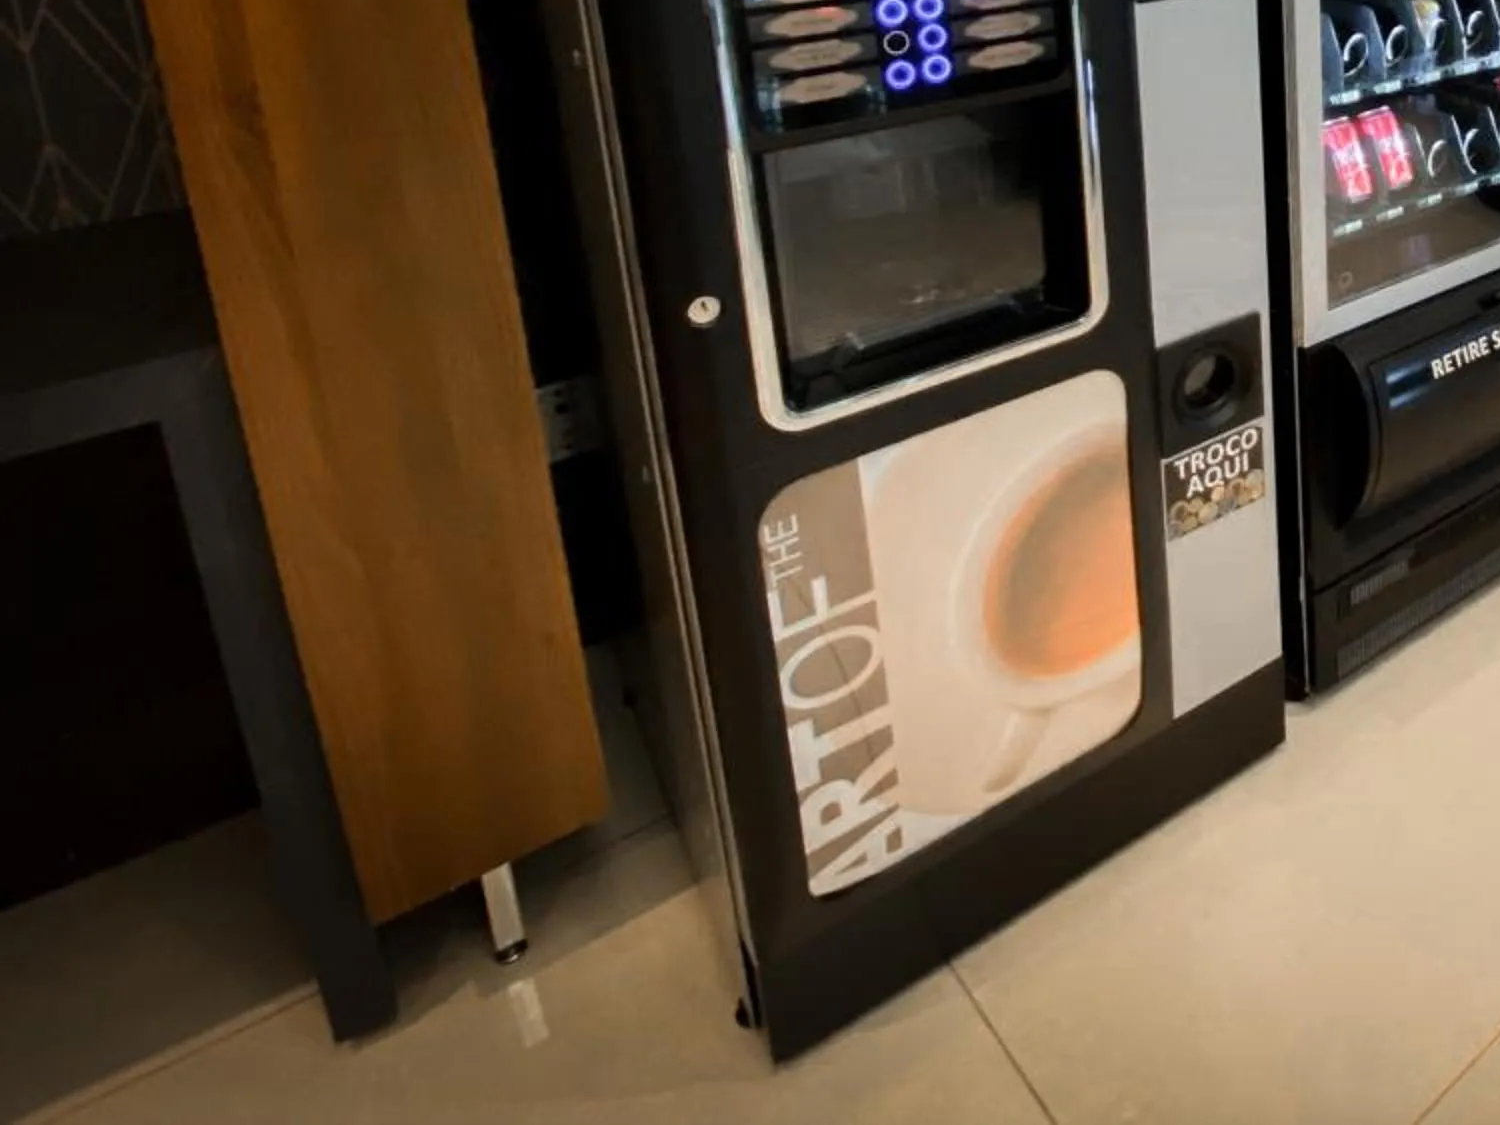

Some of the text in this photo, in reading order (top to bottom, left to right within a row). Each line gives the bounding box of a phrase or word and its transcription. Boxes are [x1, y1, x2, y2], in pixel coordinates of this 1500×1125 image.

[1430, 336, 1491, 380] RETIRE
[1174, 428, 1258, 480] TROCO
[1186, 451, 1249, 499] AQUI
[764, 513, 804, 588] THE
